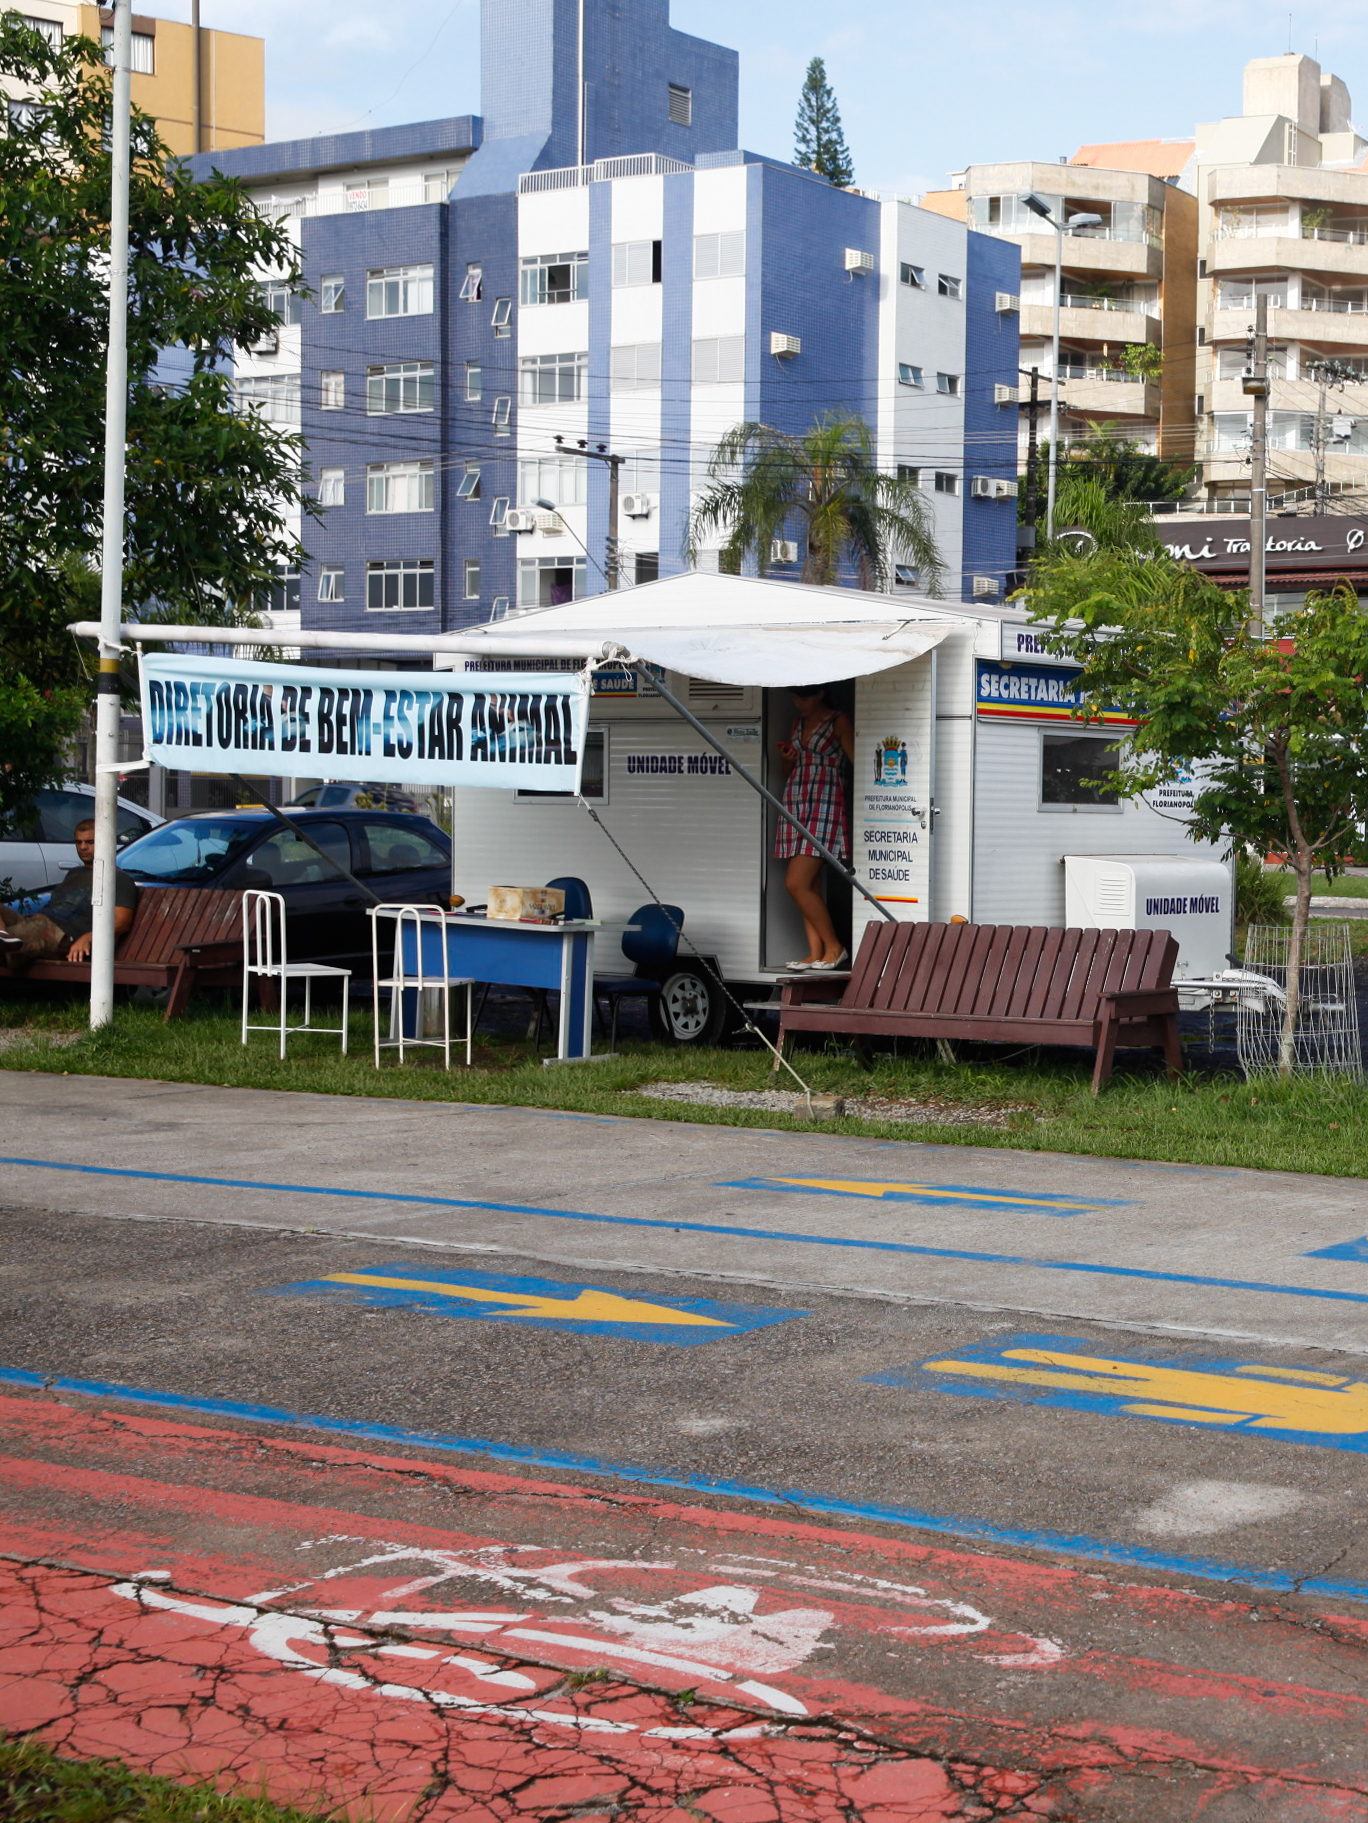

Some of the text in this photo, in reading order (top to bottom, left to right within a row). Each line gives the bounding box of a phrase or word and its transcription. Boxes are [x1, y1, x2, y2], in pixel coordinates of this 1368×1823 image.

[348, 190, 367, 200] VENDO
[1223, 535, 1323, 553] Tratoria
[513, 659, 559, 671] MUNICIPAL
[560, 658, 571, 670] DE
[600, 675, 635, 690] SAÚDE
[149, 680, 577, 765] DIRETORIA DE BEM-ESTAR ANIMAL
[627, 752, 731, 775] UNIDADE MÓVEL
[864, 795, 917, 803] PREFEITURA MUNICIPAL
[876, 803, 912, 811] FLORIANÓPOLIS
[864, 830, 918, 844] SECRETARIA
[868, 849, 913, 863] MUNICIPAL
[1146, 893, 1220, 915] UNIDADE MÓVEL
